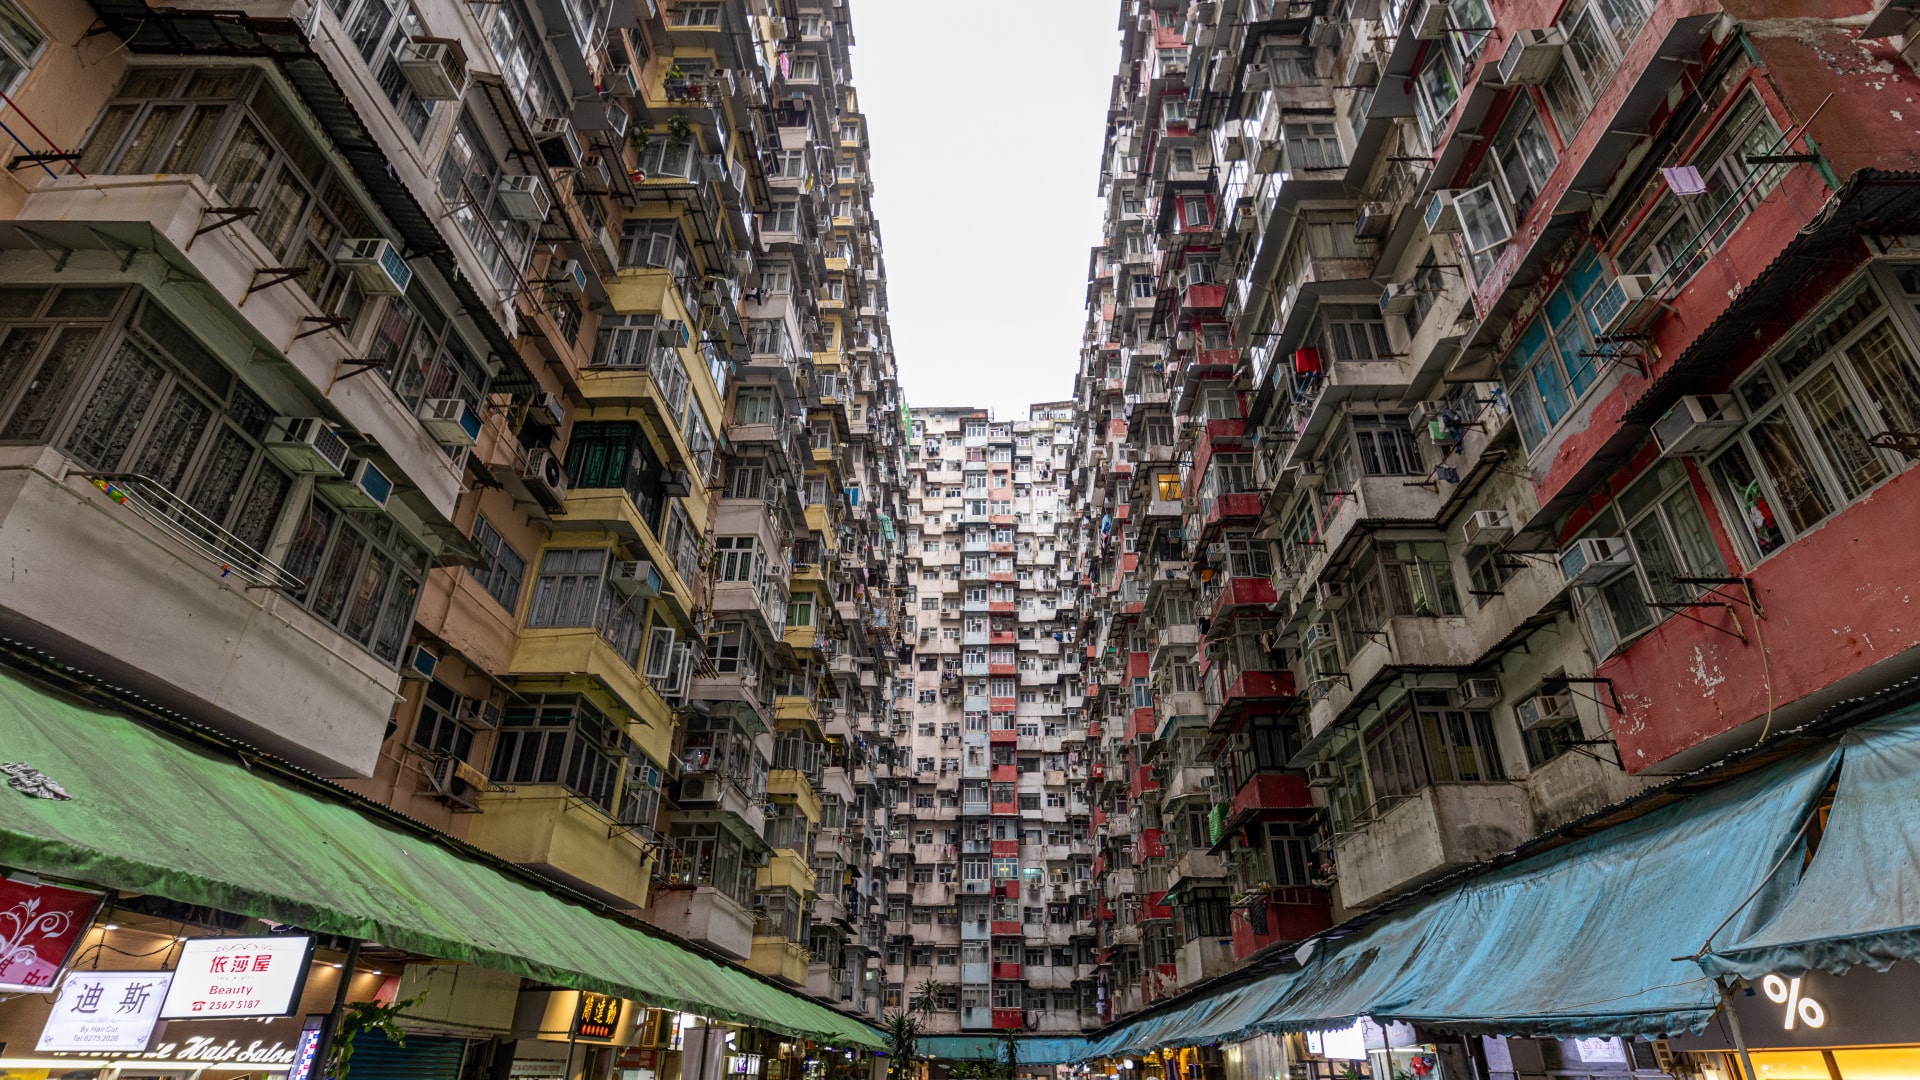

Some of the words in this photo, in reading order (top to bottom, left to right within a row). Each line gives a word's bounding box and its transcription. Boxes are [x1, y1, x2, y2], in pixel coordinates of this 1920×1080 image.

[209, 954, 273, 974] 依莎屋
[70, 982, 153, 1014] 迪斯
[209, 985, 253, 996] Beauty
[208, 1001, 235, 1010] 2567
[236, 999, 260, 1009] 5187
[1763, 974, 1825, 1030] %
[79, 1025, 90, 1034] By
[90, 1025, 106, 1033] Hair
[105, 1025, 119, 1033] Cut
[176, 1036, 240, 1061] Hair
[236, 1040, 297, 1063] Salon
